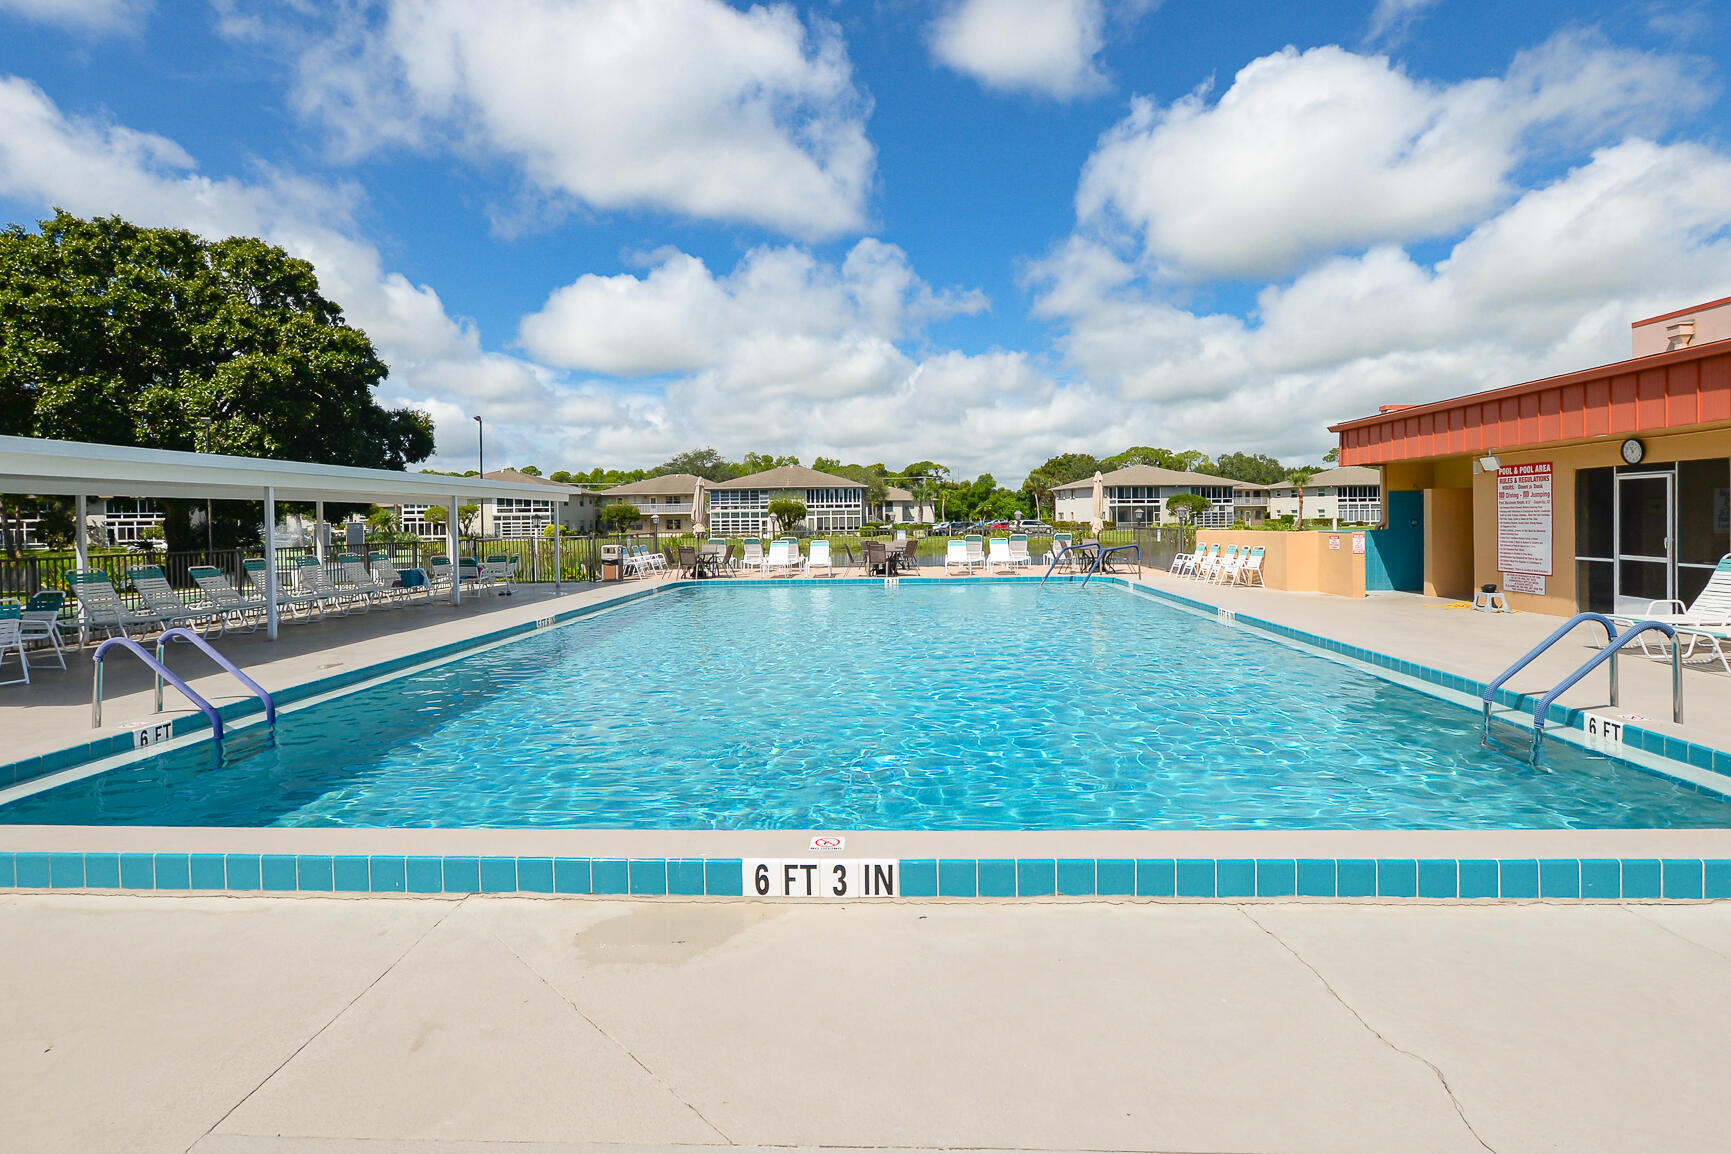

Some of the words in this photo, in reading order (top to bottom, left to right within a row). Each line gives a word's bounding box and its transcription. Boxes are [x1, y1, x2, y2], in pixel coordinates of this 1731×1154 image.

[1498, 467, 1513, 475] POOL
[1514, 466, 1518, 474] &
[1519, 465, 1534, 474] POOL
[1535, 464, 1551, 473] AREA
[1518, 475, 1550, 483] REGULATIONS
[1530, 490, 1550, 499] Jumping
[140, 729, 148, 746] 6
[155, 722, 171, 742] FT
[1589, 717, 1597, 735] 6
[1603, 720, 1621, 741] FT
[755, 864, 769, 896] 6
[784, 864, 817, 896] FT
[832, 864, 847, 896] 3
[864, 864, 893, 896] IN
